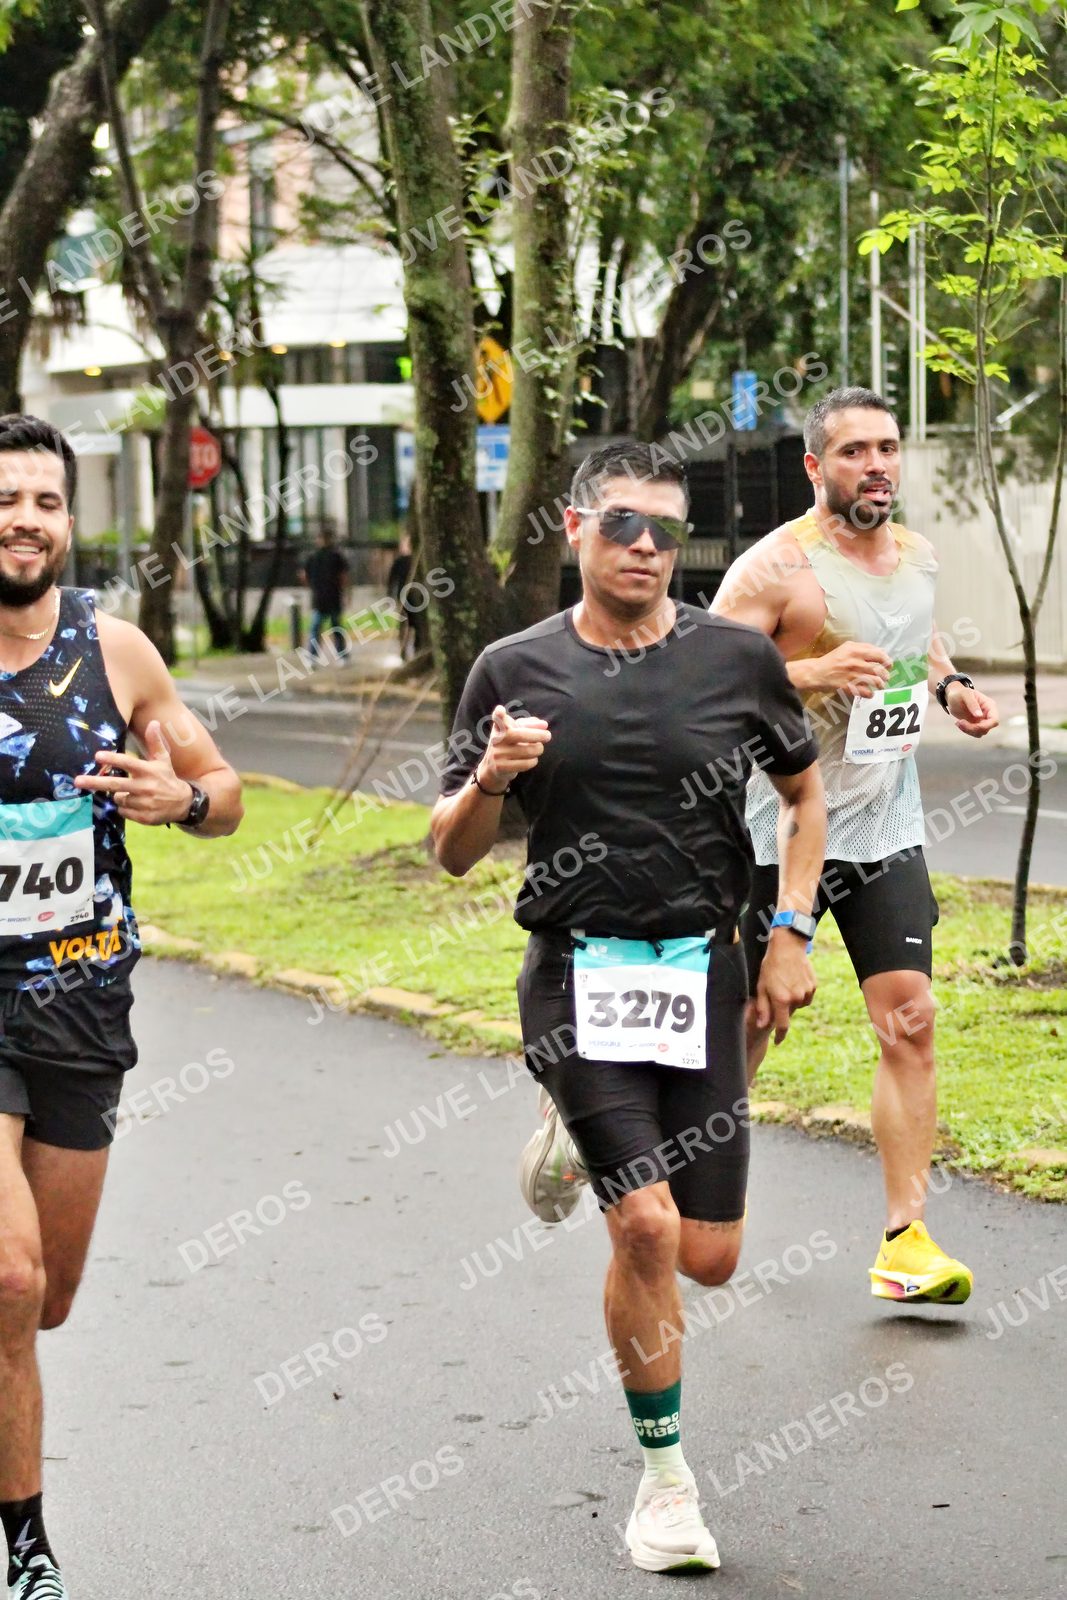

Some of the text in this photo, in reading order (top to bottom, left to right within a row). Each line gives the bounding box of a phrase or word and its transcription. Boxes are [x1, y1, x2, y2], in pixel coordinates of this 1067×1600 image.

[866, 703, 920, 738] 822
[0, 857, 84, 902] 740
[49, 925, 121, 967] VOLTA
[588, 990, 695, 1033] 3279
